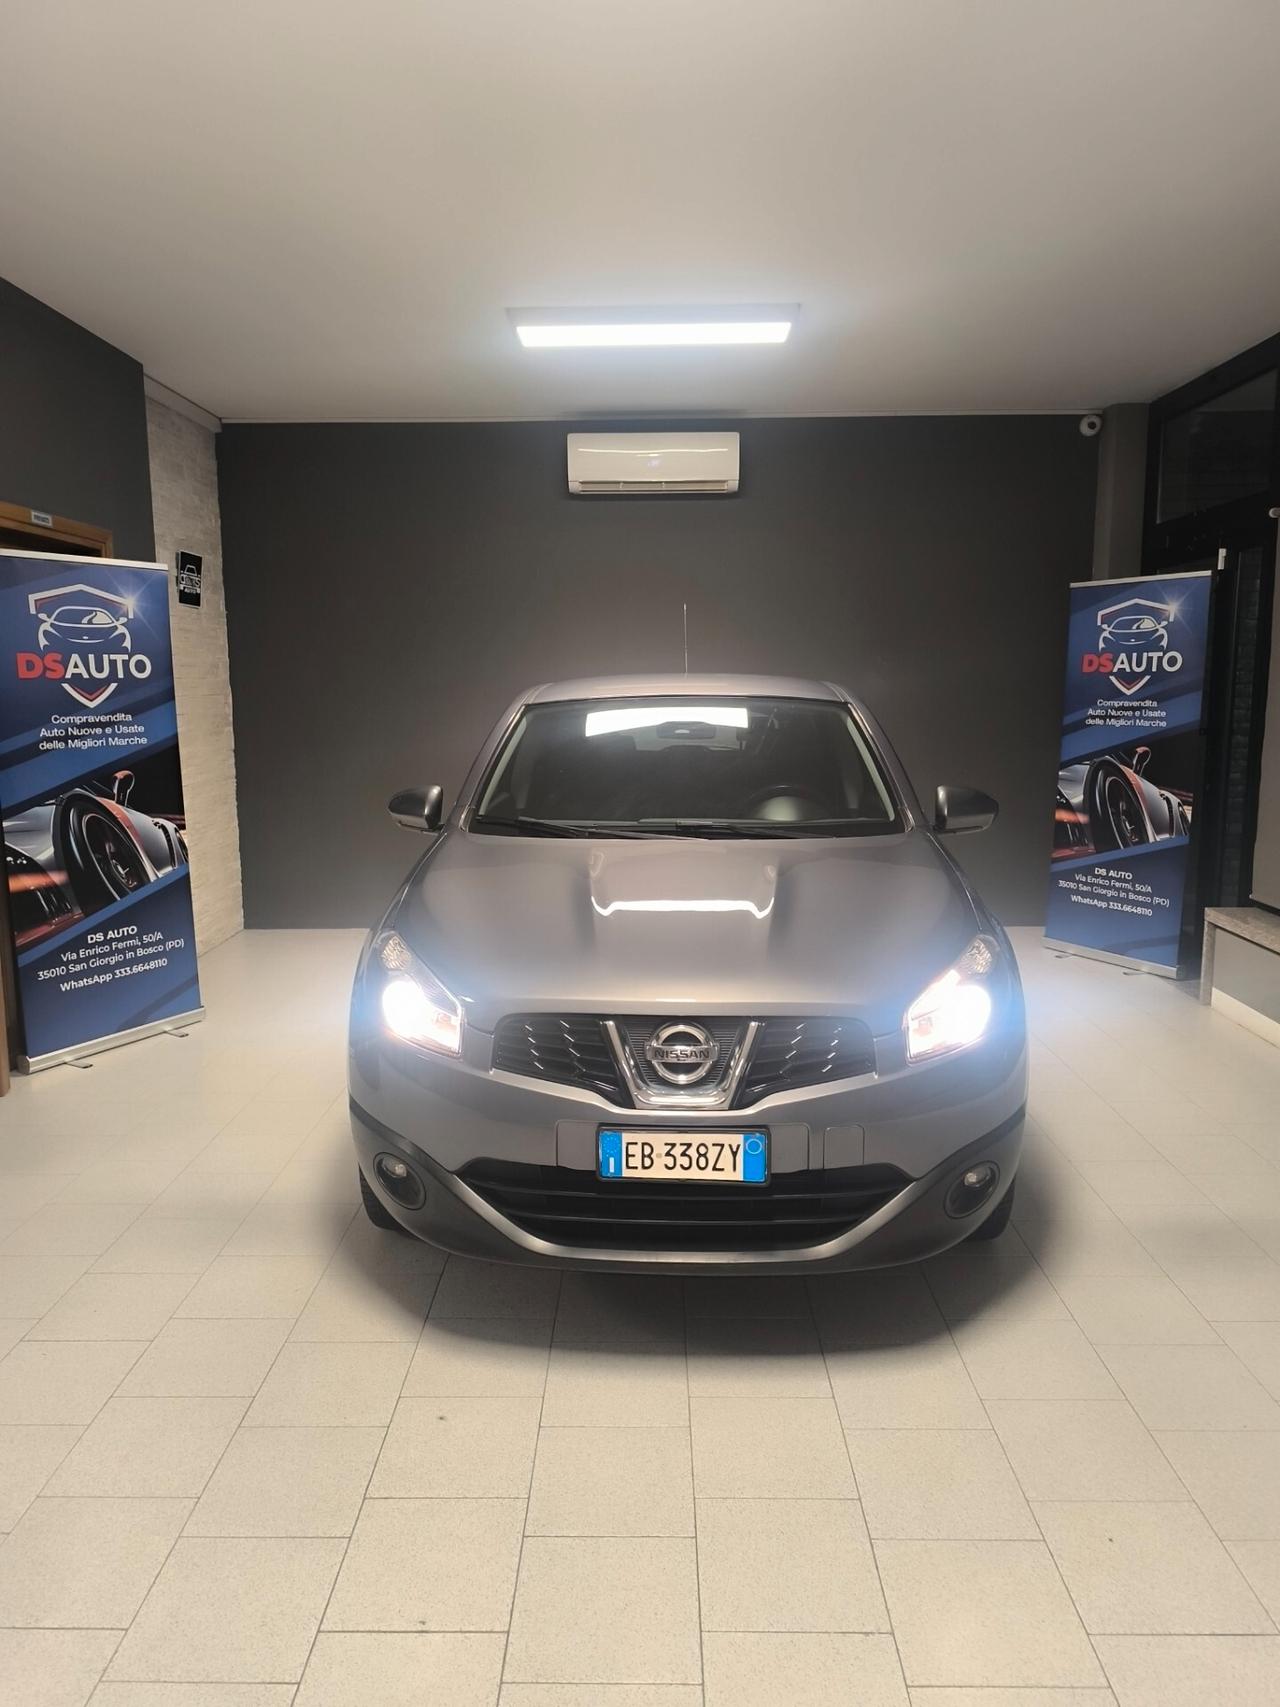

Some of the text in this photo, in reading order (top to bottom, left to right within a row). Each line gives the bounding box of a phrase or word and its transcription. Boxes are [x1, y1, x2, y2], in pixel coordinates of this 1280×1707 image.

[16, 652, 152, 680] DSAUTO
[1082, 651, 1183, 673] DSAUTO
[1087, 708, 1106, 716] Auto
[1107, 709, 1133, 717] Nuove
[1142, 709, 1166, 718] Usate
[1097, 699, 1158, 708] Compravendita
[51, 713, 132, 725] Compravendita
[1085, 717, 1167, 728] delle Migliori Marche
[39, 724, 145, 738] Auto Nuove e Usate
[39, 735, 147, 751] delle Migliori Marche
[1075, 873, 1152, 893] Via Enrico Fermi, 50/A
[1094, 867, 1133, 880] DS AUTO
[1058, 880, 1170, 908] 35010 San Giorgio in Bosco (PD)
[1071, 894, 1153, 917] WhatsApp 333.6648110
[87, 925, 138, 944] DS AUTO
[60, 931, 163, 962] Via Enrico Fermi, 50/A
[37, 938, 185, 981] 35010 San Giorgio in Bosco (PD)
[60, 958, 168, 992] WhatsApp 333.6648110
[653, 1049, 711, 1060] NISSAN
